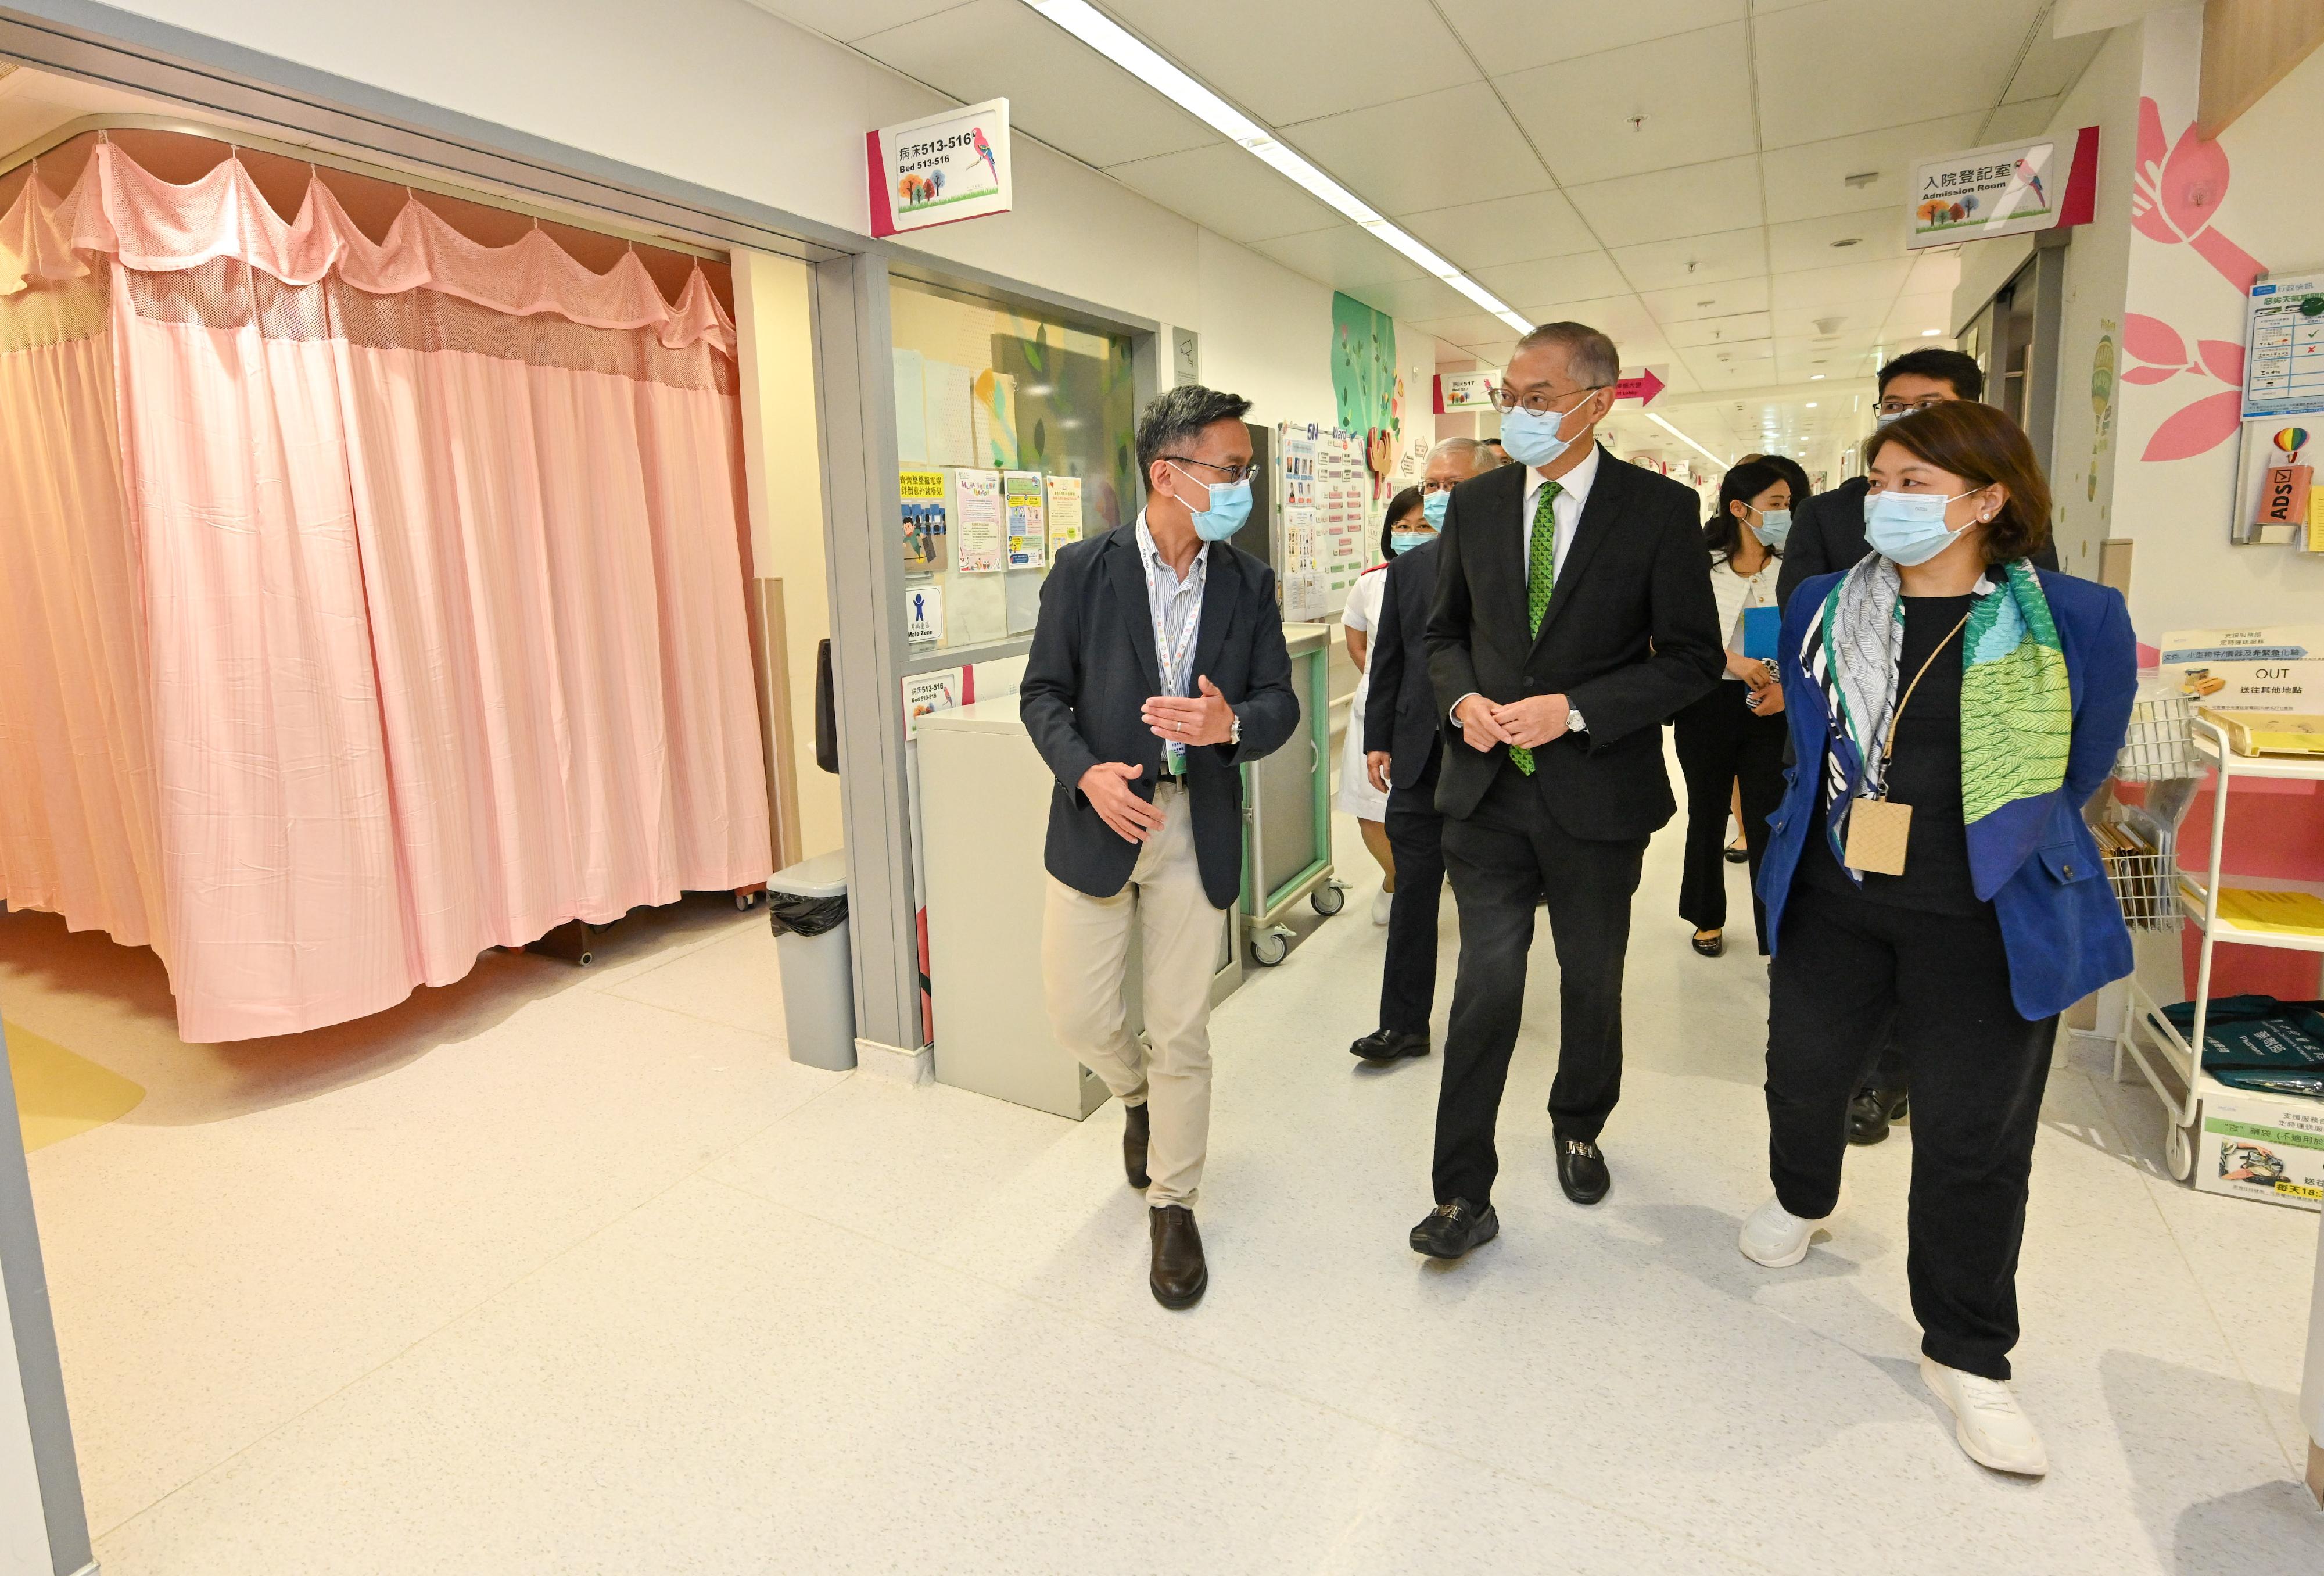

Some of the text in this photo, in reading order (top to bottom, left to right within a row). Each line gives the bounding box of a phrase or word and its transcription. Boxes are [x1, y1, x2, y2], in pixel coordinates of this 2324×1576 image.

[899, 132, 971, 161] 病床513-516
[899, 155, 949, 173] Bed 513-516
[1924, 163, 2011, 191] 入院登記室
[1922, 182, 2006, 200] Admission Room
[1307, 423, 1347, 441] 5N Ward
[2270, 483, 2293, 520] ADS
[2255, 669, 2290, 679] OUT
[2240, 686, 2303, 694] 送往其他地點
